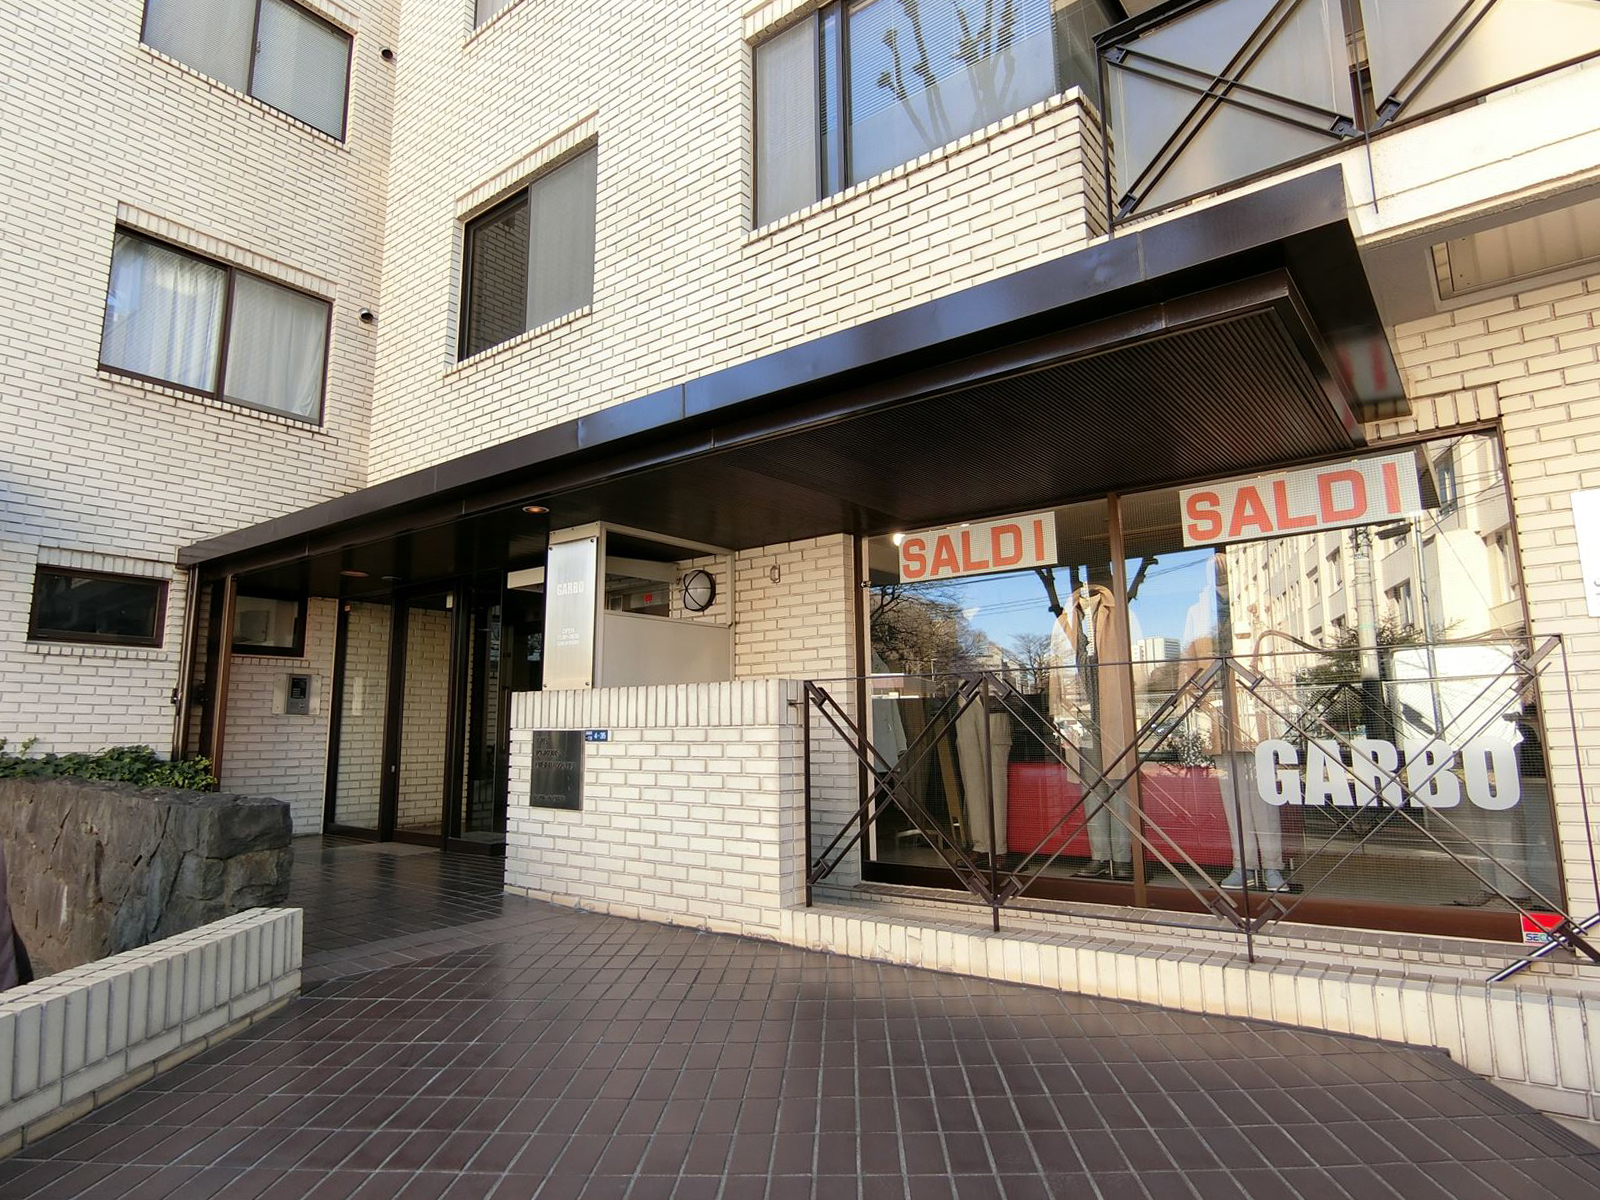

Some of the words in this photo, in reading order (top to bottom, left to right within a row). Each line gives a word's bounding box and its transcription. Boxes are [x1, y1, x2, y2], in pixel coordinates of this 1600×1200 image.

[1185, 461, 1403, 542] SALDI
[902, 518, 1045, 579] SALDI
[557, 580, 584, 595] GARBO
[1255, 737, 1521, 811] GARBO
